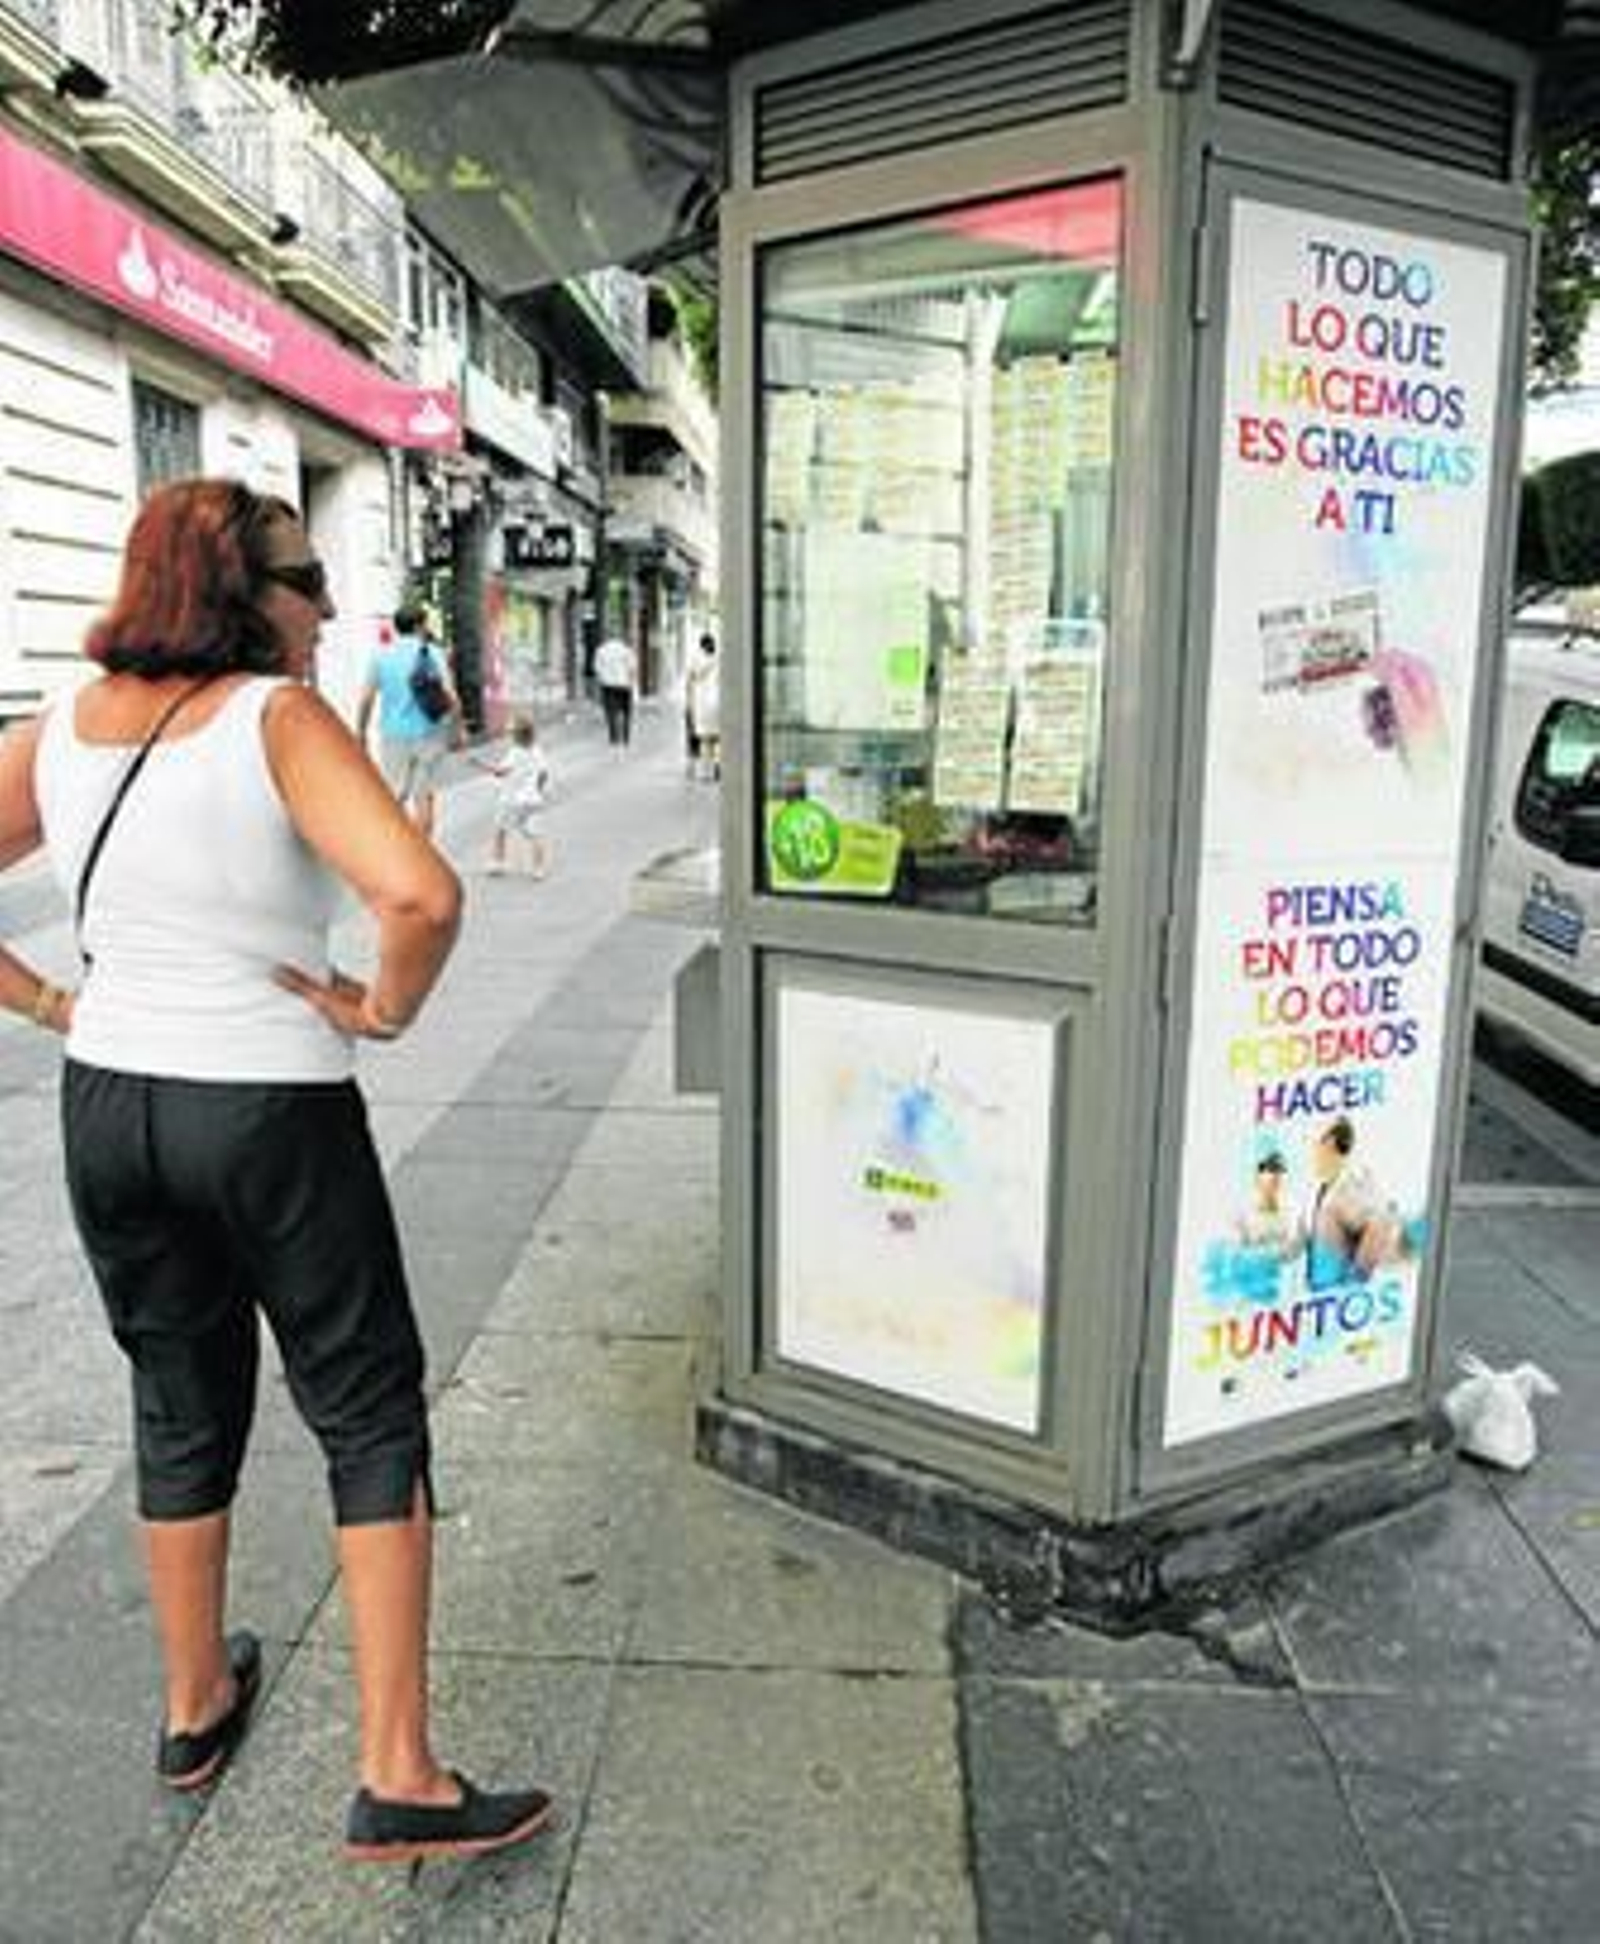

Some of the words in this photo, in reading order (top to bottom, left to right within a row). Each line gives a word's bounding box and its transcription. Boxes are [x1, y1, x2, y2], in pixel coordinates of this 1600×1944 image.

[1307, 240, 1433, 307] TODO
[1286, 300, 1346, 352] LO
[1355, 313, 1446, 369] QUE
[1258, 354, 1465, 430] HACEMOS
[1237, 417, 1287, 464] ES
[1296, 425, 1476, 486] GRACIAS
[1315, 488, 1346, 530] A
[1354, 490, 1395, 534] TI
[1266, 882, 1403, 927] PIENSA
[1242, 937, 1297, 978] EN
[1306, 927, 1421, 970] TODO
[1257, 986, 1309, 1025] LO
[1318, 977, 1401, 1020] QUE
[1228, 1019, 1419, 1072] PODEMOS
[1256, 1070, 1384, 1121] HACER
[1192, 1281, 1402, 1370] JUNTOS
